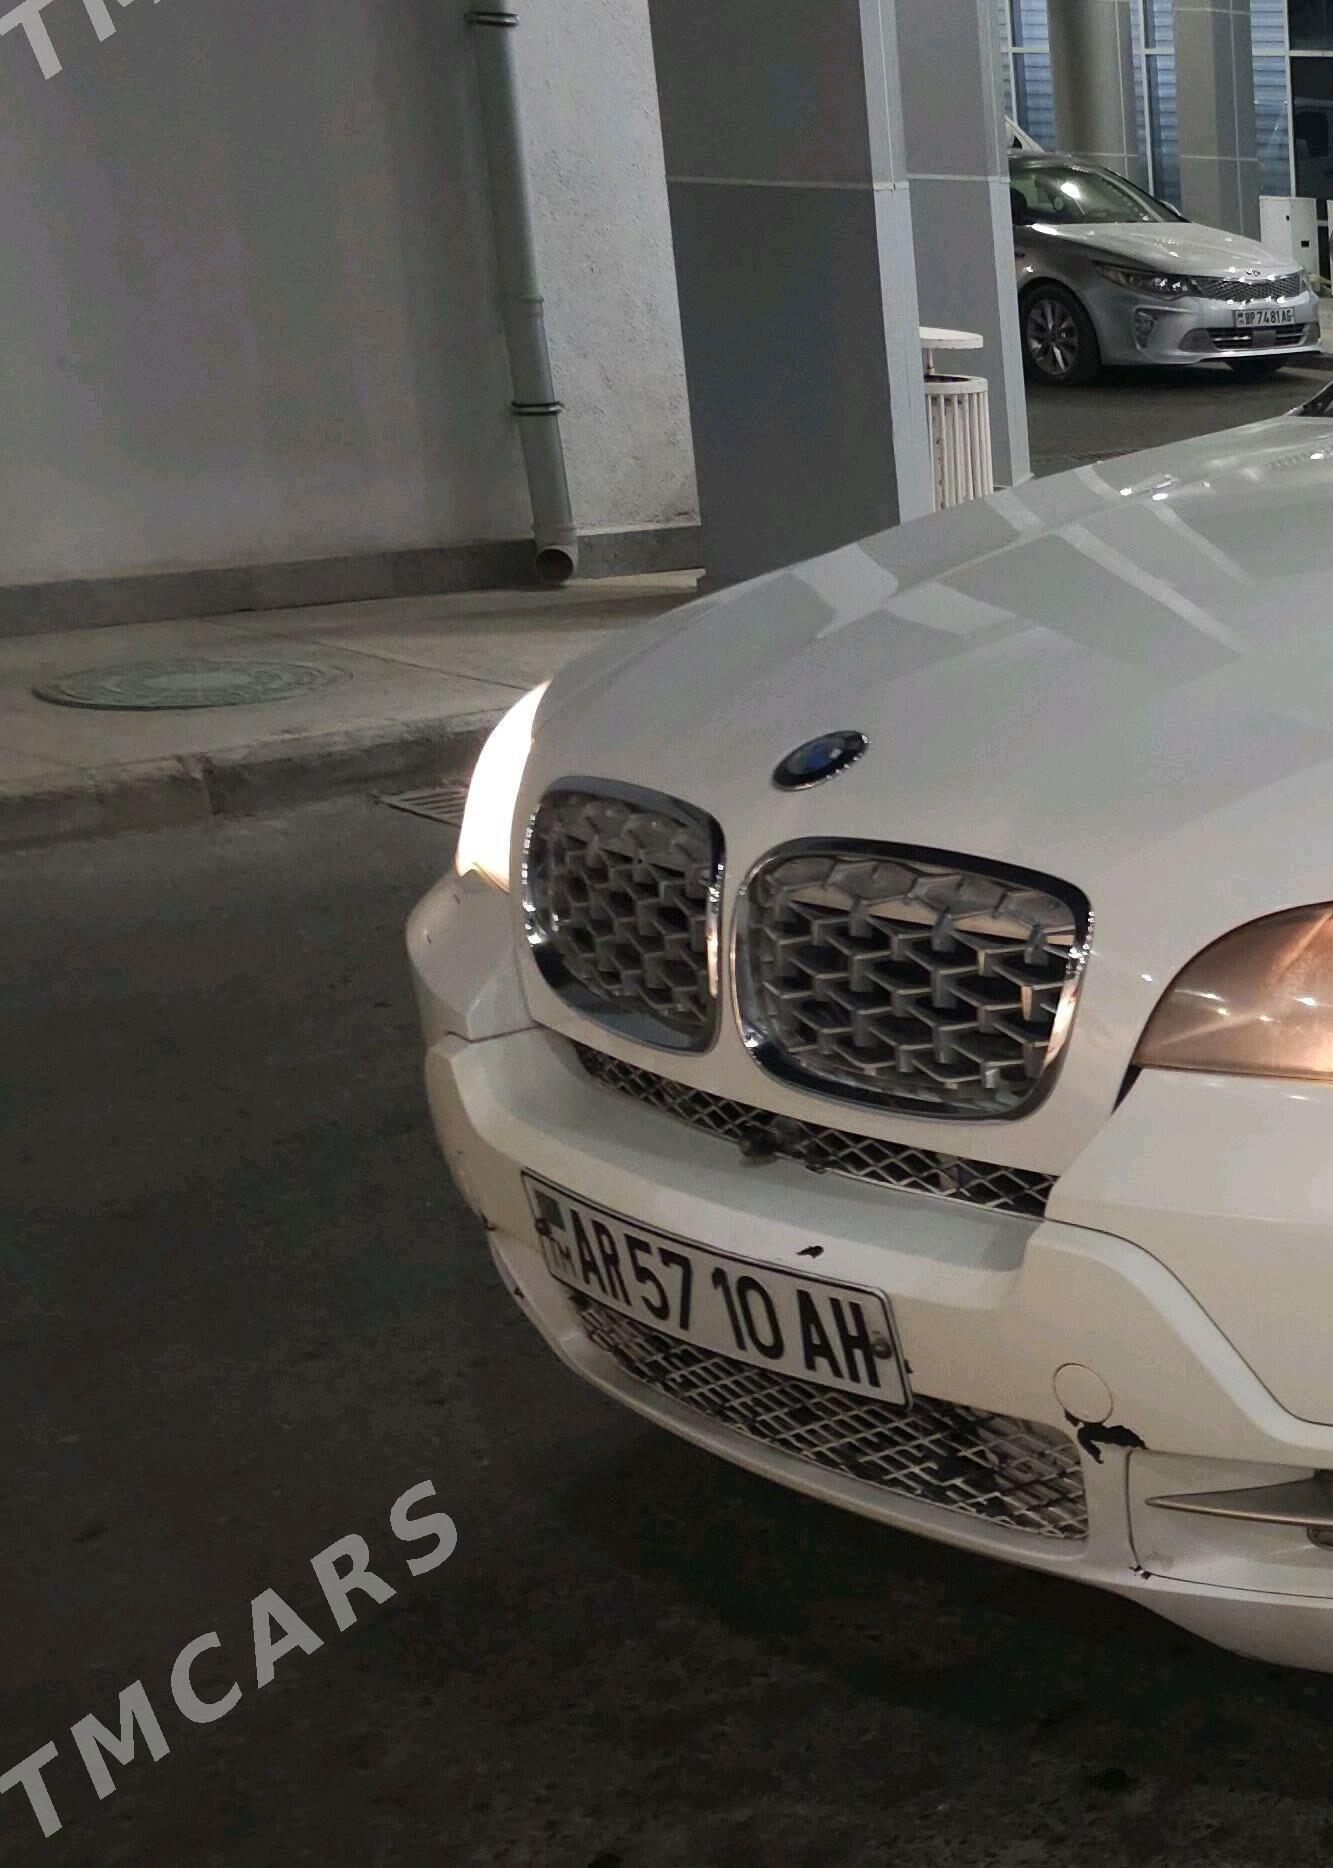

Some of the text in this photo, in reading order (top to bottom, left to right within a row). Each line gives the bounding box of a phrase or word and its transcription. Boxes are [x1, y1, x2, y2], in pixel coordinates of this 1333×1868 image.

[568, 1207, 632, 1306] AR
[623, 1232, 694, 1333] 57
[709, 1266, 786, 1361] 10
[796, 1288, 882, 1389] AH
